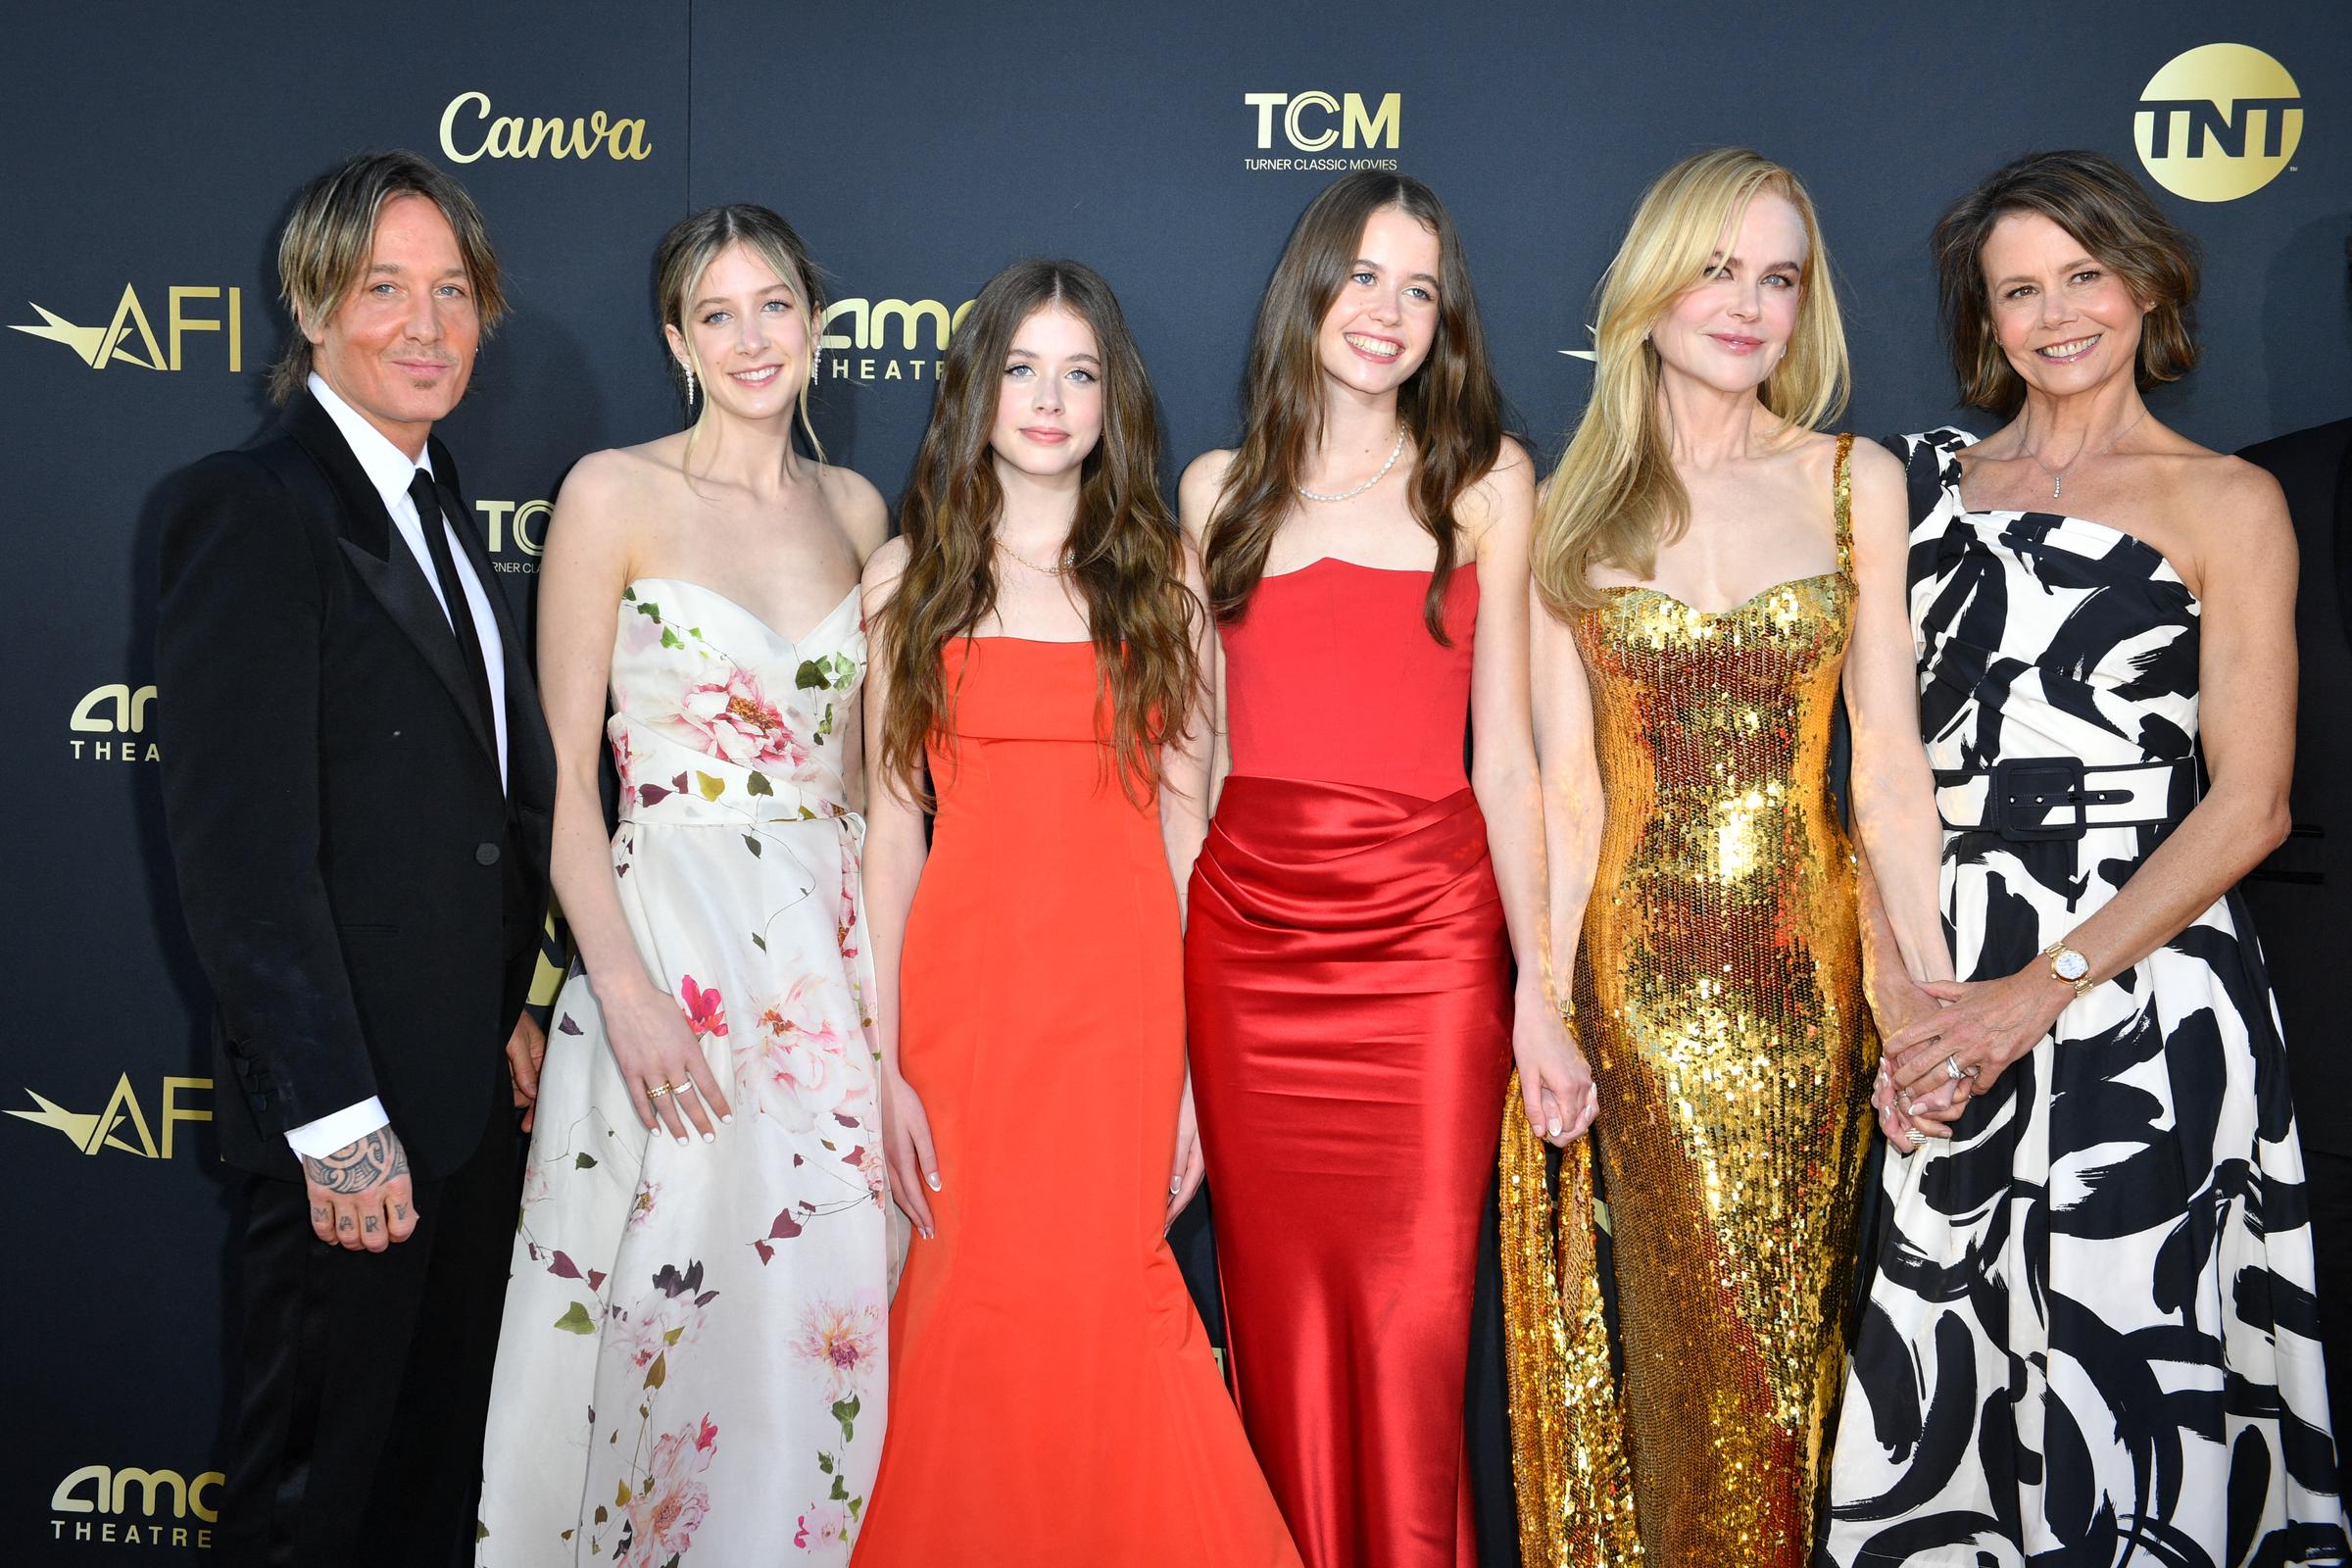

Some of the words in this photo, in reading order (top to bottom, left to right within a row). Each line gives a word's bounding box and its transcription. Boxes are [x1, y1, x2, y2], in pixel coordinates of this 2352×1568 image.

[440, 92, 652, 164] Canva
[1245, 91, 1400, 152] TCM
[2134, 98, 2303, 159] TNT
[1245, 159, 1292, 171] TURNER
[1295, 159, 1348, 171] CLASSIC
[1350, 159, 1397, 171] MOVIES
[93, 281, 241, 372] AFI
[70, 740, 161, 761] THEA
[84, 1071, 225, 1161] AF
[51, 1465, 225, 1523] amc
[51, 1520, 212, 1548] THEATRE
